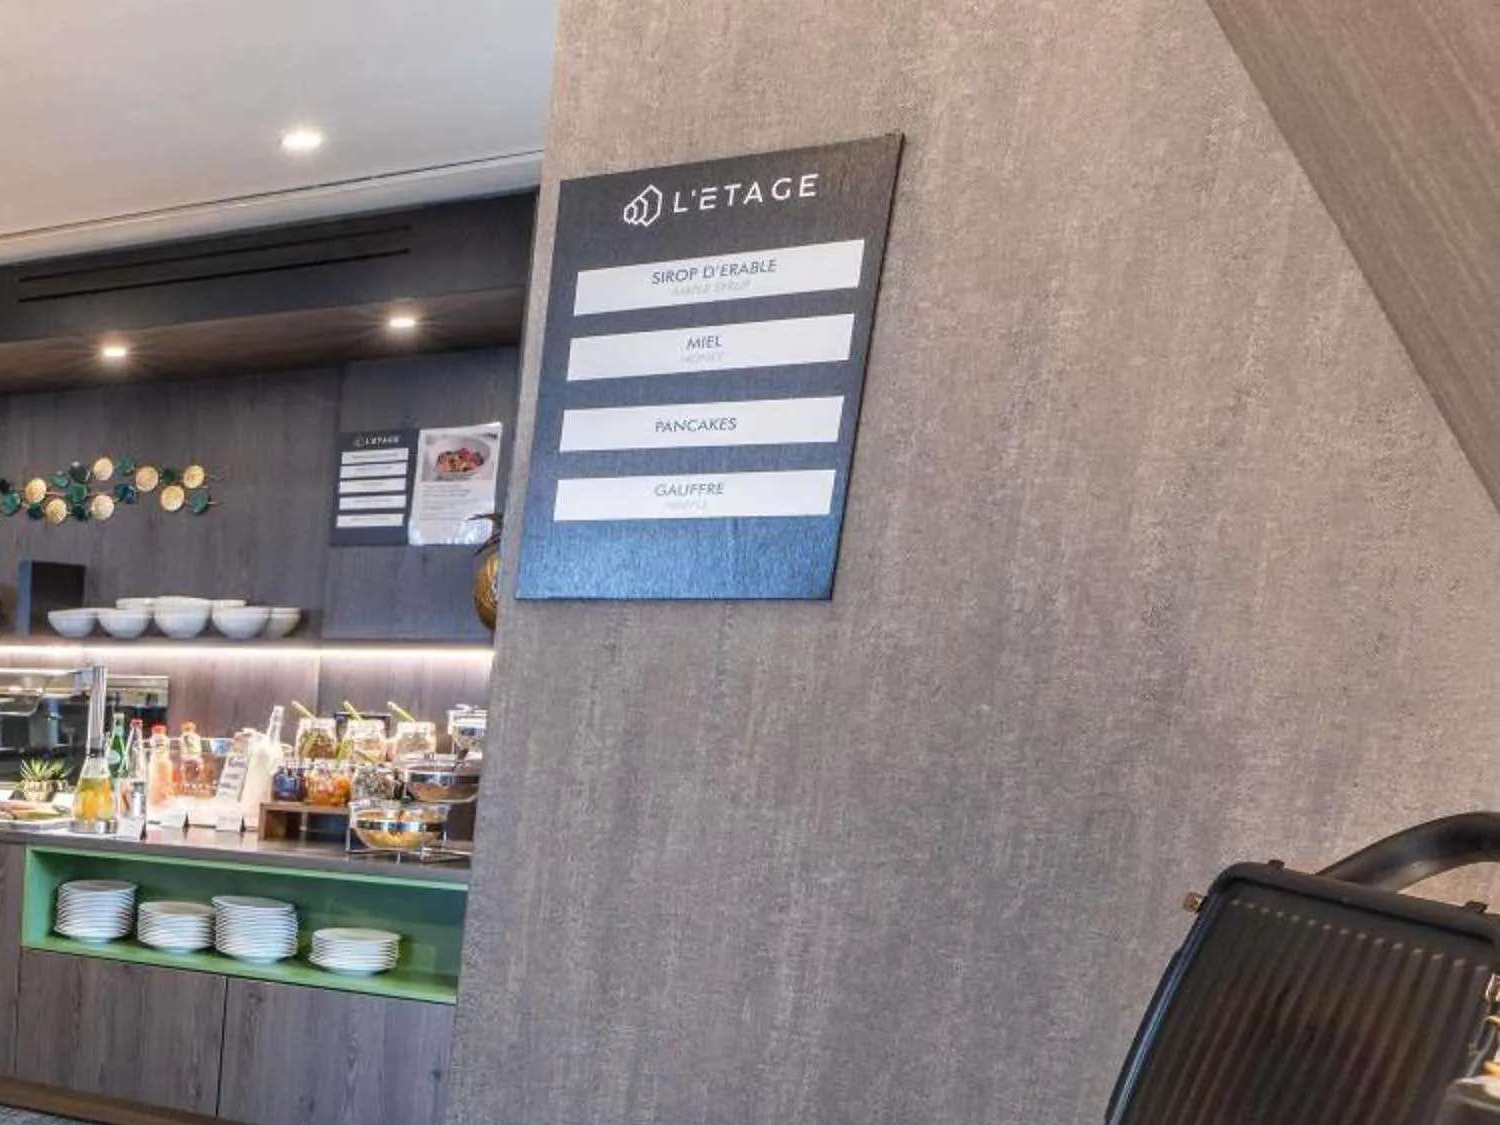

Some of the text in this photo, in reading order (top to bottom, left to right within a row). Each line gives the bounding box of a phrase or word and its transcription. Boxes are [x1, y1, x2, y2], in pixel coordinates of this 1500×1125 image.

[673, 173, 820, 213] L'ETAGE
[651, 259, 777, 285] SIROP D'ERABLE
[685, 335, 723, 350] MIEL
[655, 417, 738, 433] PANCAKES
[654, 482, 725, 497] GAUFFRE
